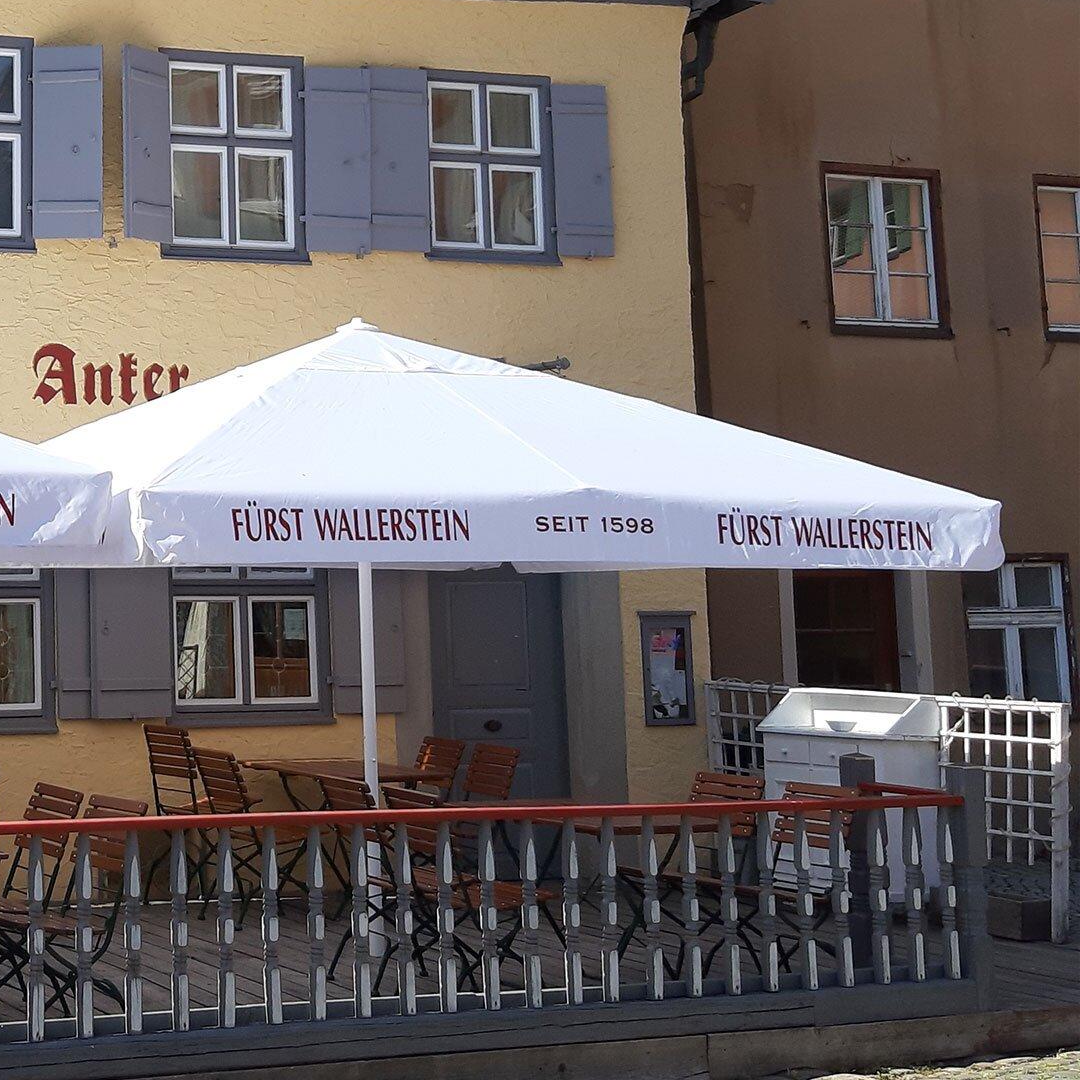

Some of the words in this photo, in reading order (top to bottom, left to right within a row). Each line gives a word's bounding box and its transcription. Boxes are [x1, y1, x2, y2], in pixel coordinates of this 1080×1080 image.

[32, 343, 190, 406] Anker
[231, 500, 304, 542] FÜRST
[313, 508, 470, 542] WALLERSTEIN
[535, 516, 589, 533] SEIT
[600, 516, 654, 534] 1598
[717, 507, 783, 547] FÜRST
[790, 516, 933, 551] WALLERSTEIN
